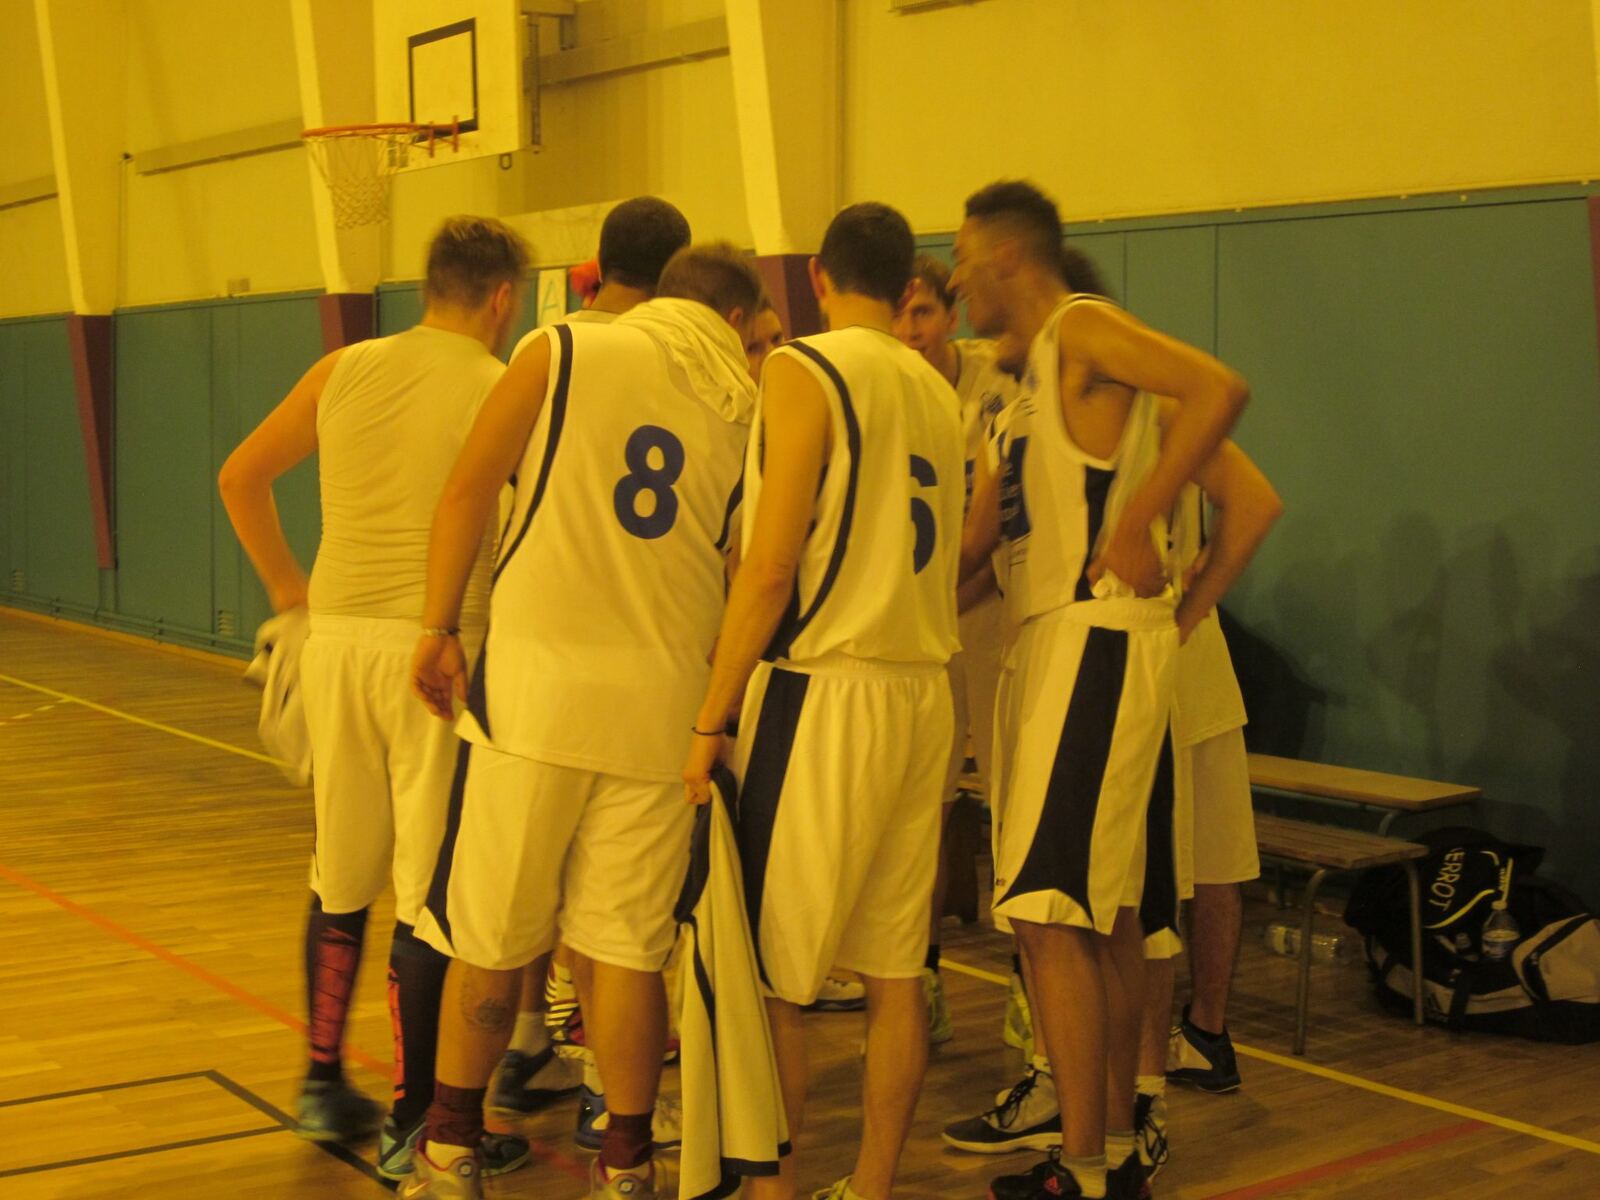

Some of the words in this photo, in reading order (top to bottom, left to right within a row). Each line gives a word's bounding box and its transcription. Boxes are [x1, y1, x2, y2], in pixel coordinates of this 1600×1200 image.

[540, 279, 561, 325] A
[613, 424, 685, 539] 8
[1429, 848, 1465, 911] ERROT
